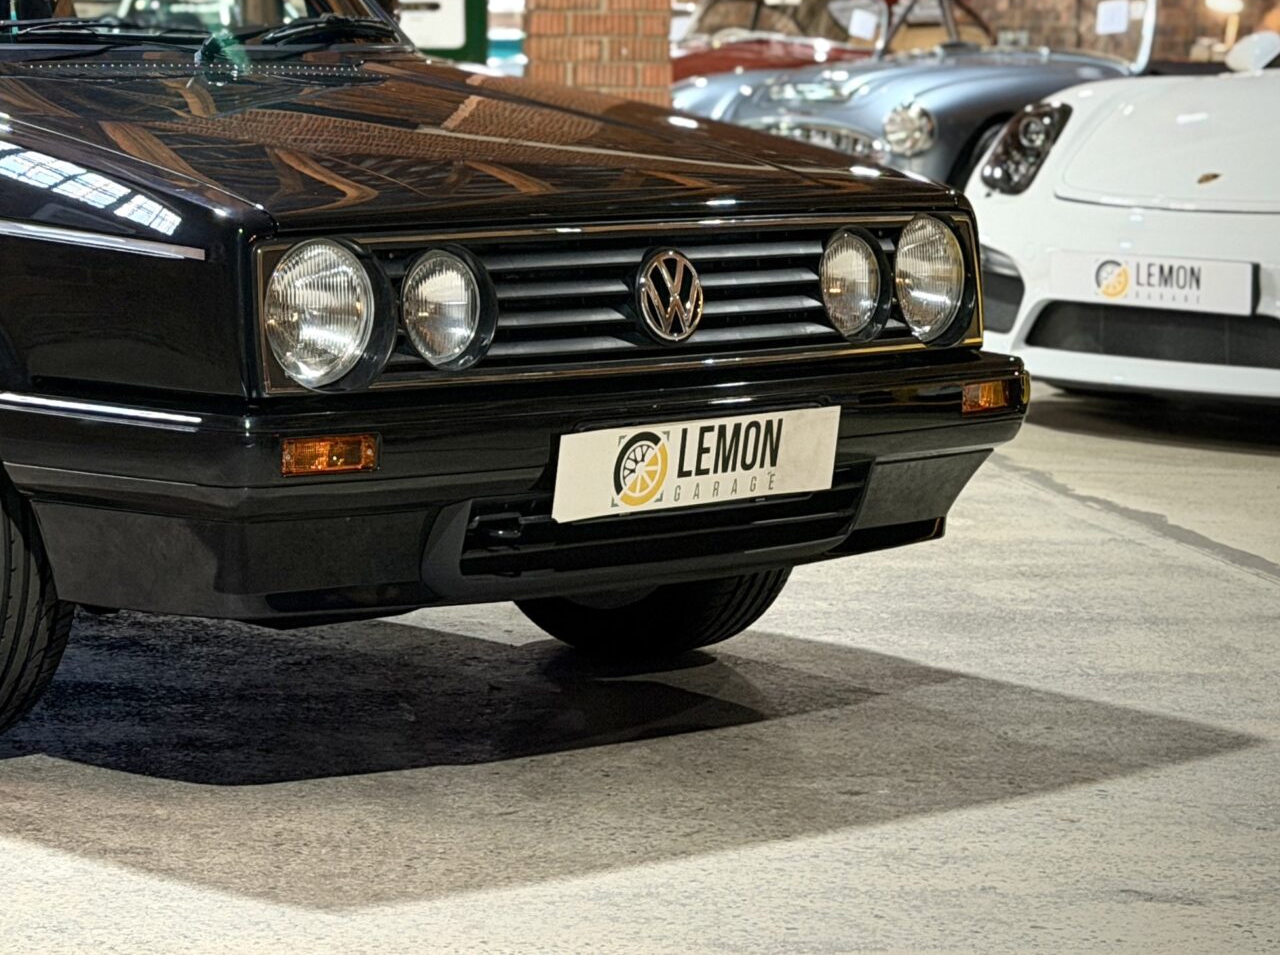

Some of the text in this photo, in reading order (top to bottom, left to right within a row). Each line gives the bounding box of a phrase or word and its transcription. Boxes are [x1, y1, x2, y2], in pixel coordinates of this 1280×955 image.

[1135, 262, 1201, 290] LEMON
[677, 418, 783, 478] LEMON
[673, 473, 775, 502] GARAGE
